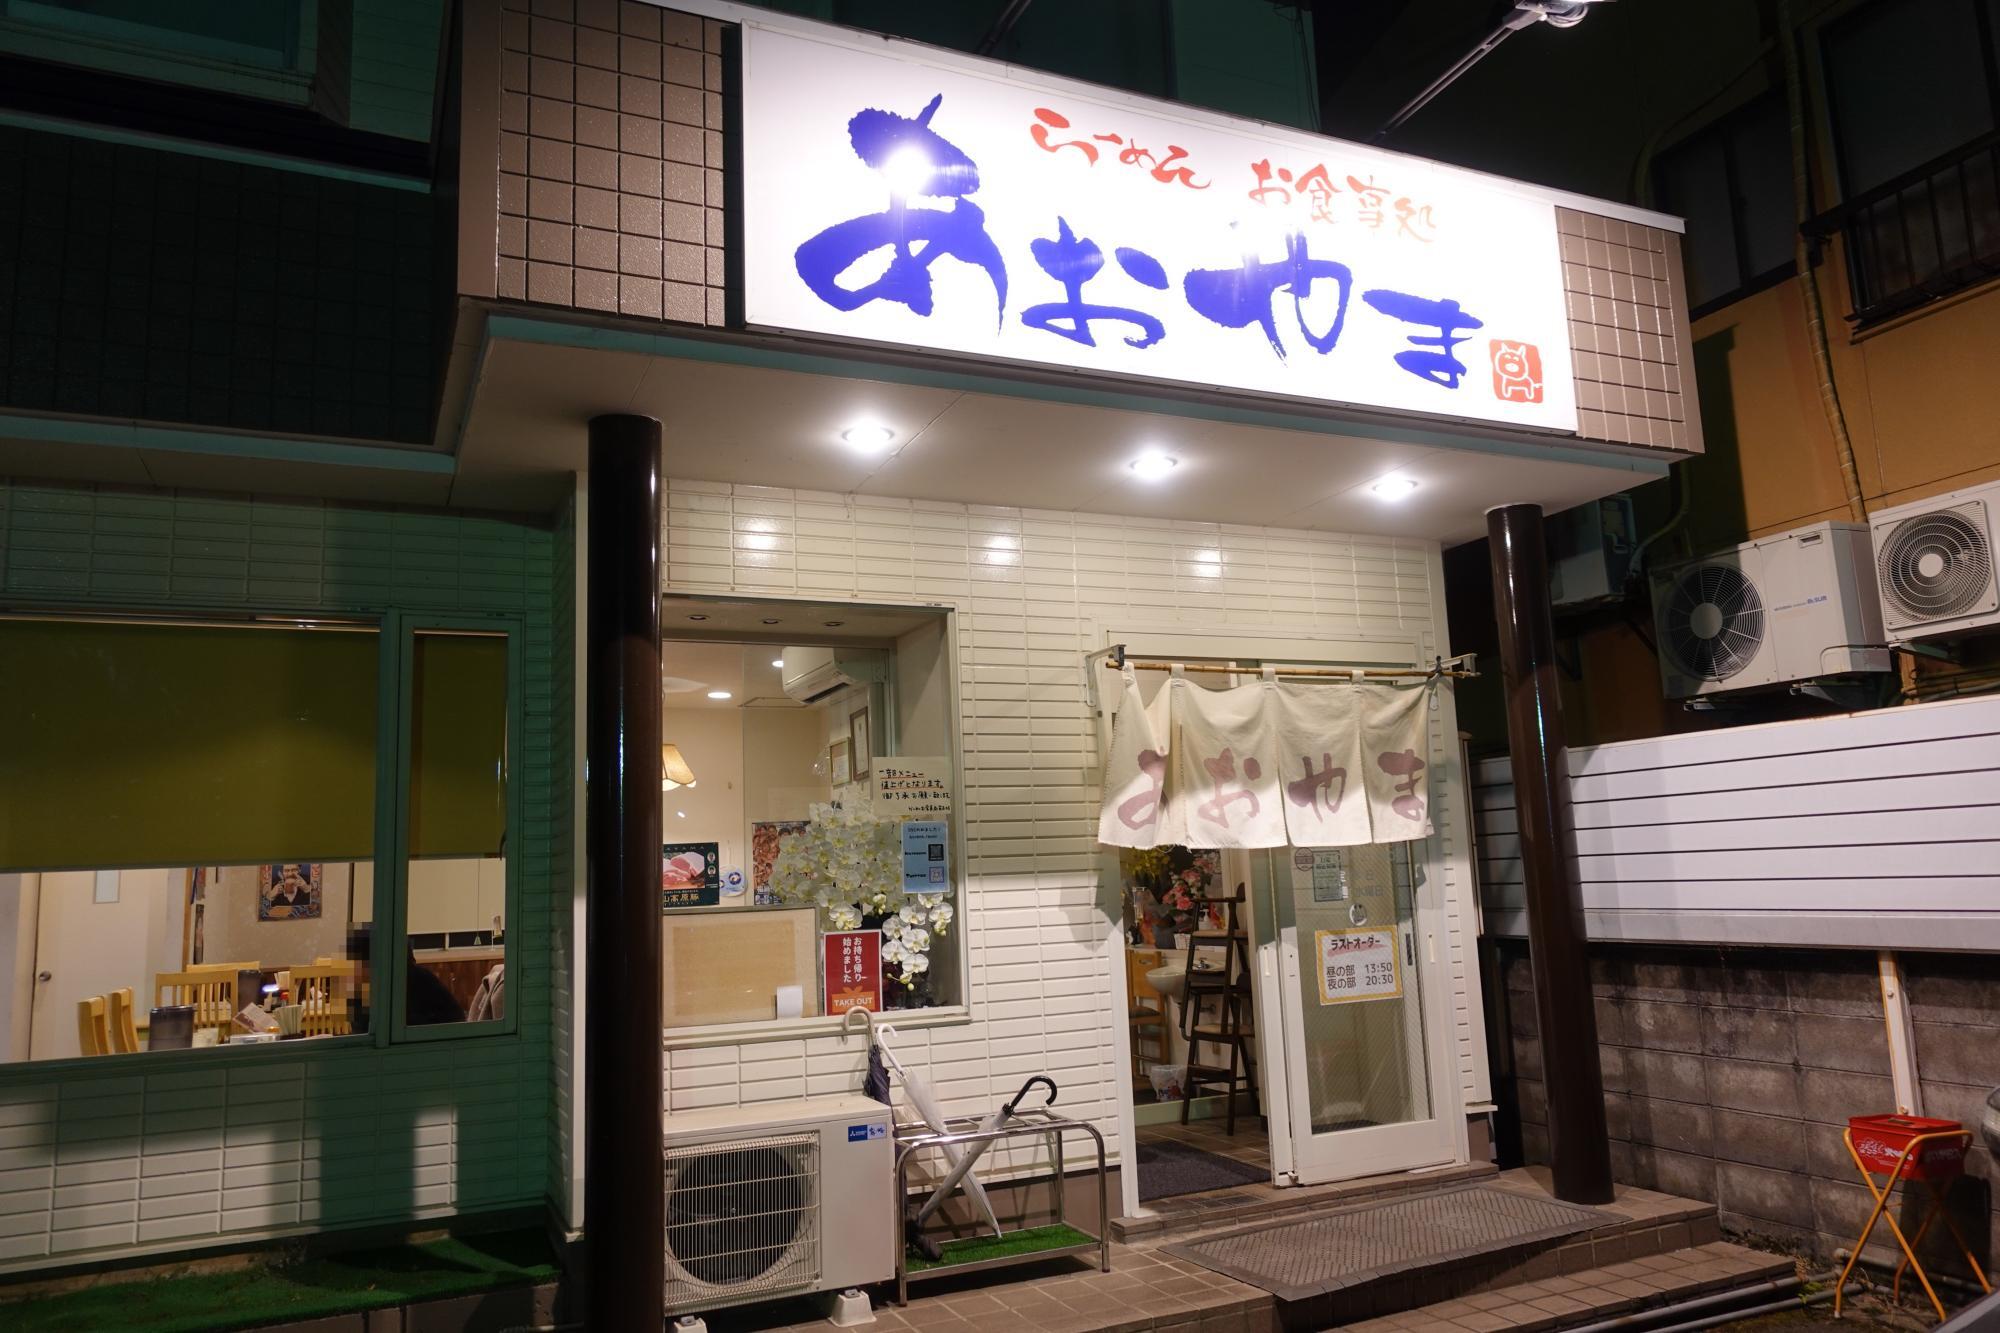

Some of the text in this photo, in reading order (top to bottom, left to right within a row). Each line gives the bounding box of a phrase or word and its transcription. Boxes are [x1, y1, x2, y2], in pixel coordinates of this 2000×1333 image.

[1030, 107, 1437, 244] らーめん お食事処
[794, 92, 1484, 390] あおやま
[1330, 934, 1382, 951] ラストオーダー
[842, 936, 853, 983] 始めました
[853, 936, 863, 983] お持ち帰り
[1327, 962, 1393, 979] 昼の部 13:50
[1328, 974, 1394, 990] 夜の部 20:30
[833, 997, 873, 1007] TAKE OUT
